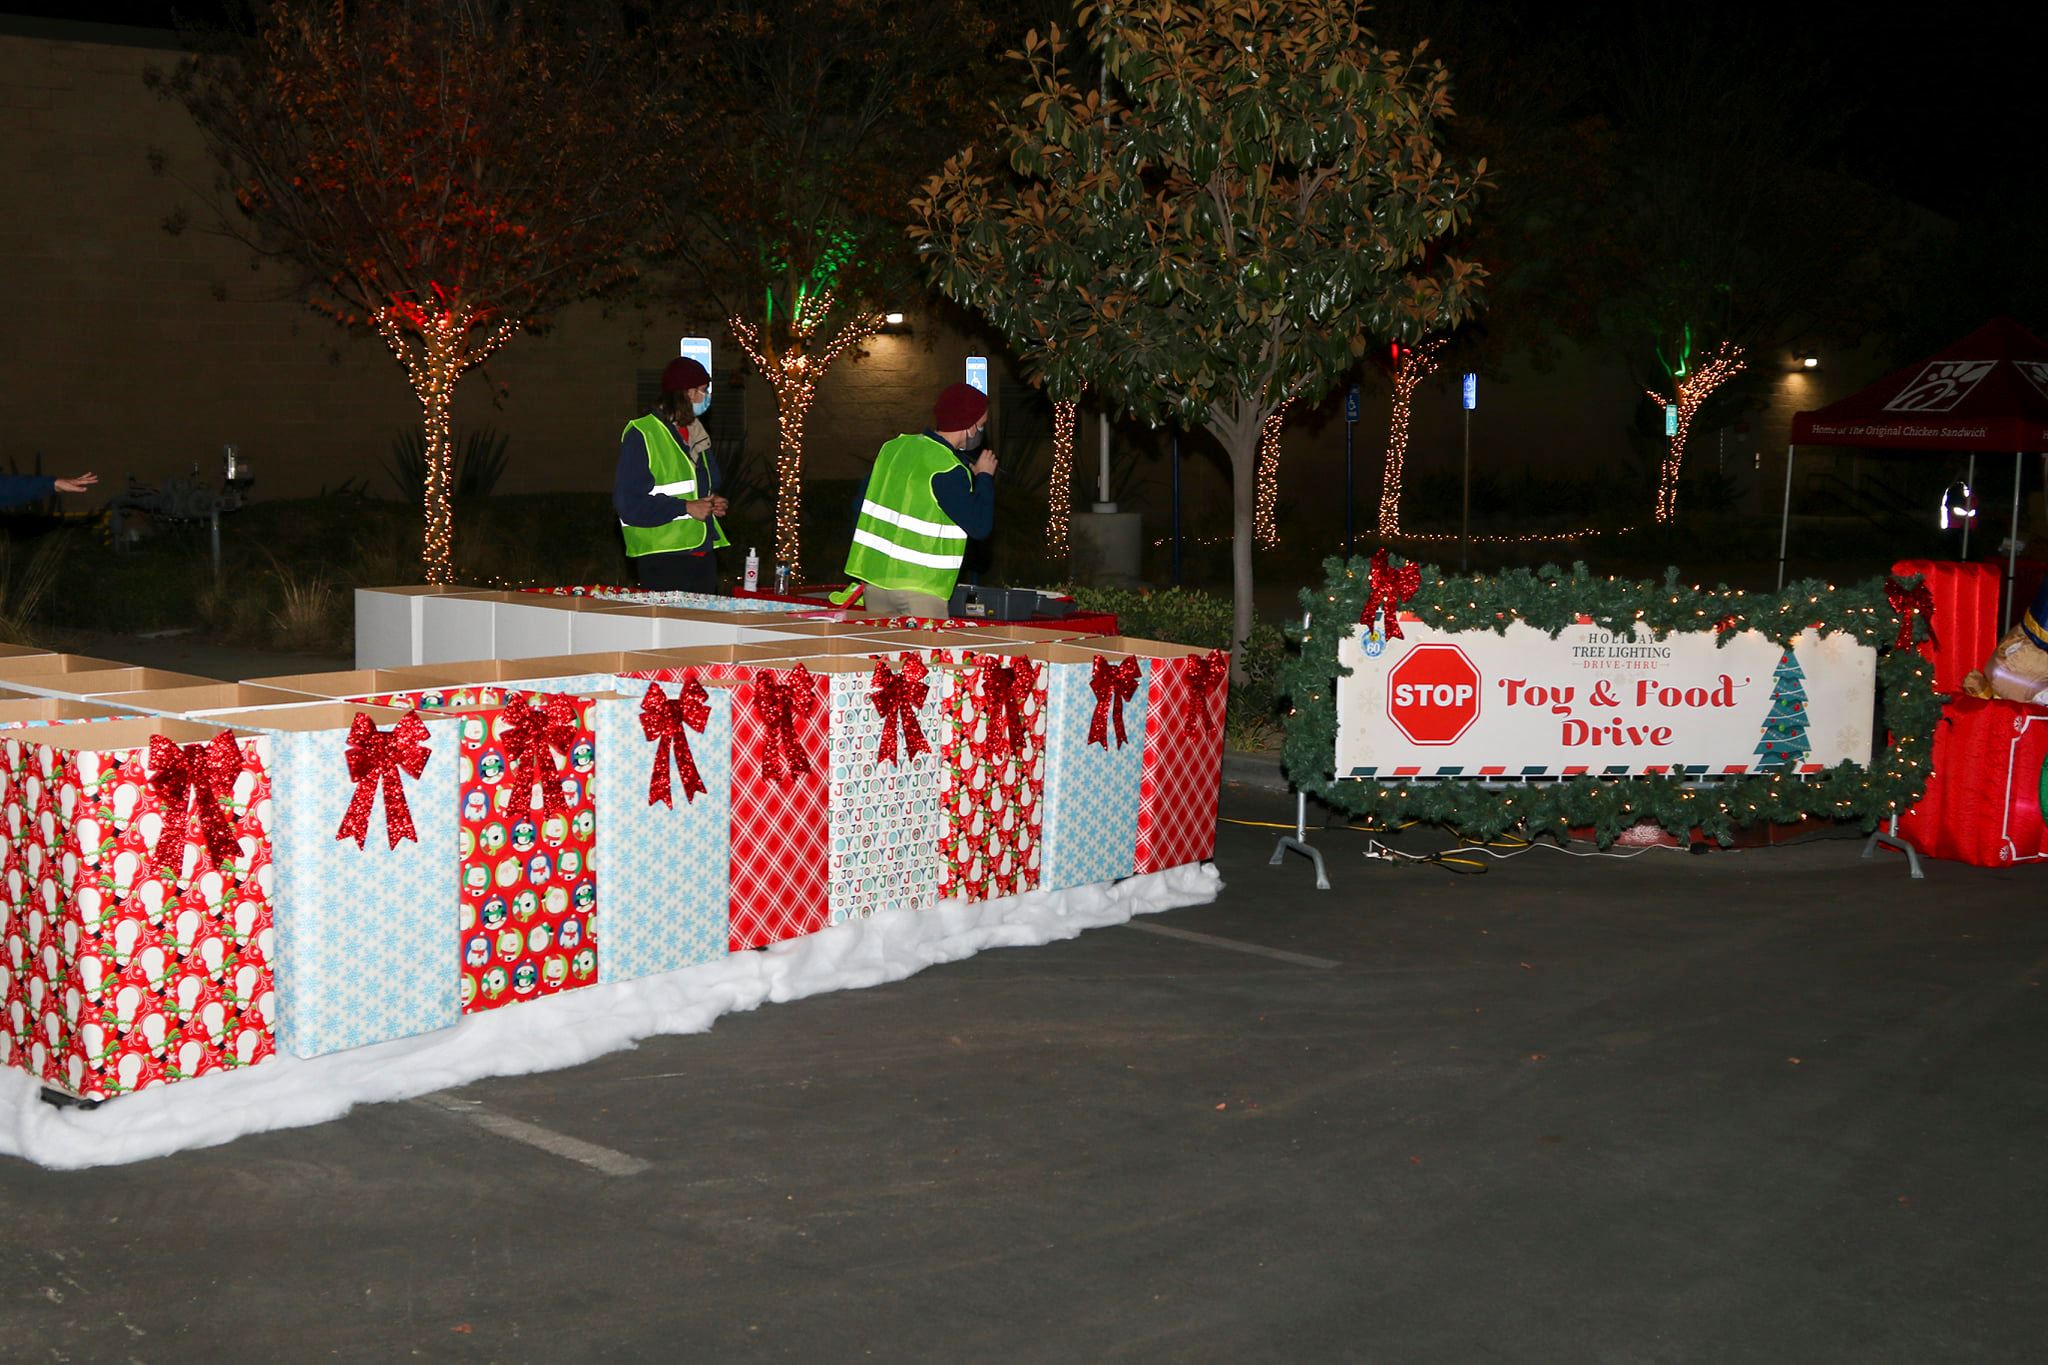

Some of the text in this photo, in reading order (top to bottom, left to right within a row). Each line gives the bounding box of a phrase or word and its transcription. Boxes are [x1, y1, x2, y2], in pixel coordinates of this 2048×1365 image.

[1811, 424, 1837, 434] Home
[1849, 425, 1865, 435] The
[1865, 425, 1902, 438] Original
[1903, 425, 1939, 437] Chicken
[1941, 426, 1986, 438] Sandwich
[1588, 633, 1655, 644] HOLIAY
[1572, 646, 1671, 658] TREE LIGHTING
[1583, 660, 1658, 669] DRIVE-THRU
[1395, 684, 1474, 708] STOP
[1498, 674, 1751, 716] Toy & Food
[1560, 716, 1674, 746] Drive
